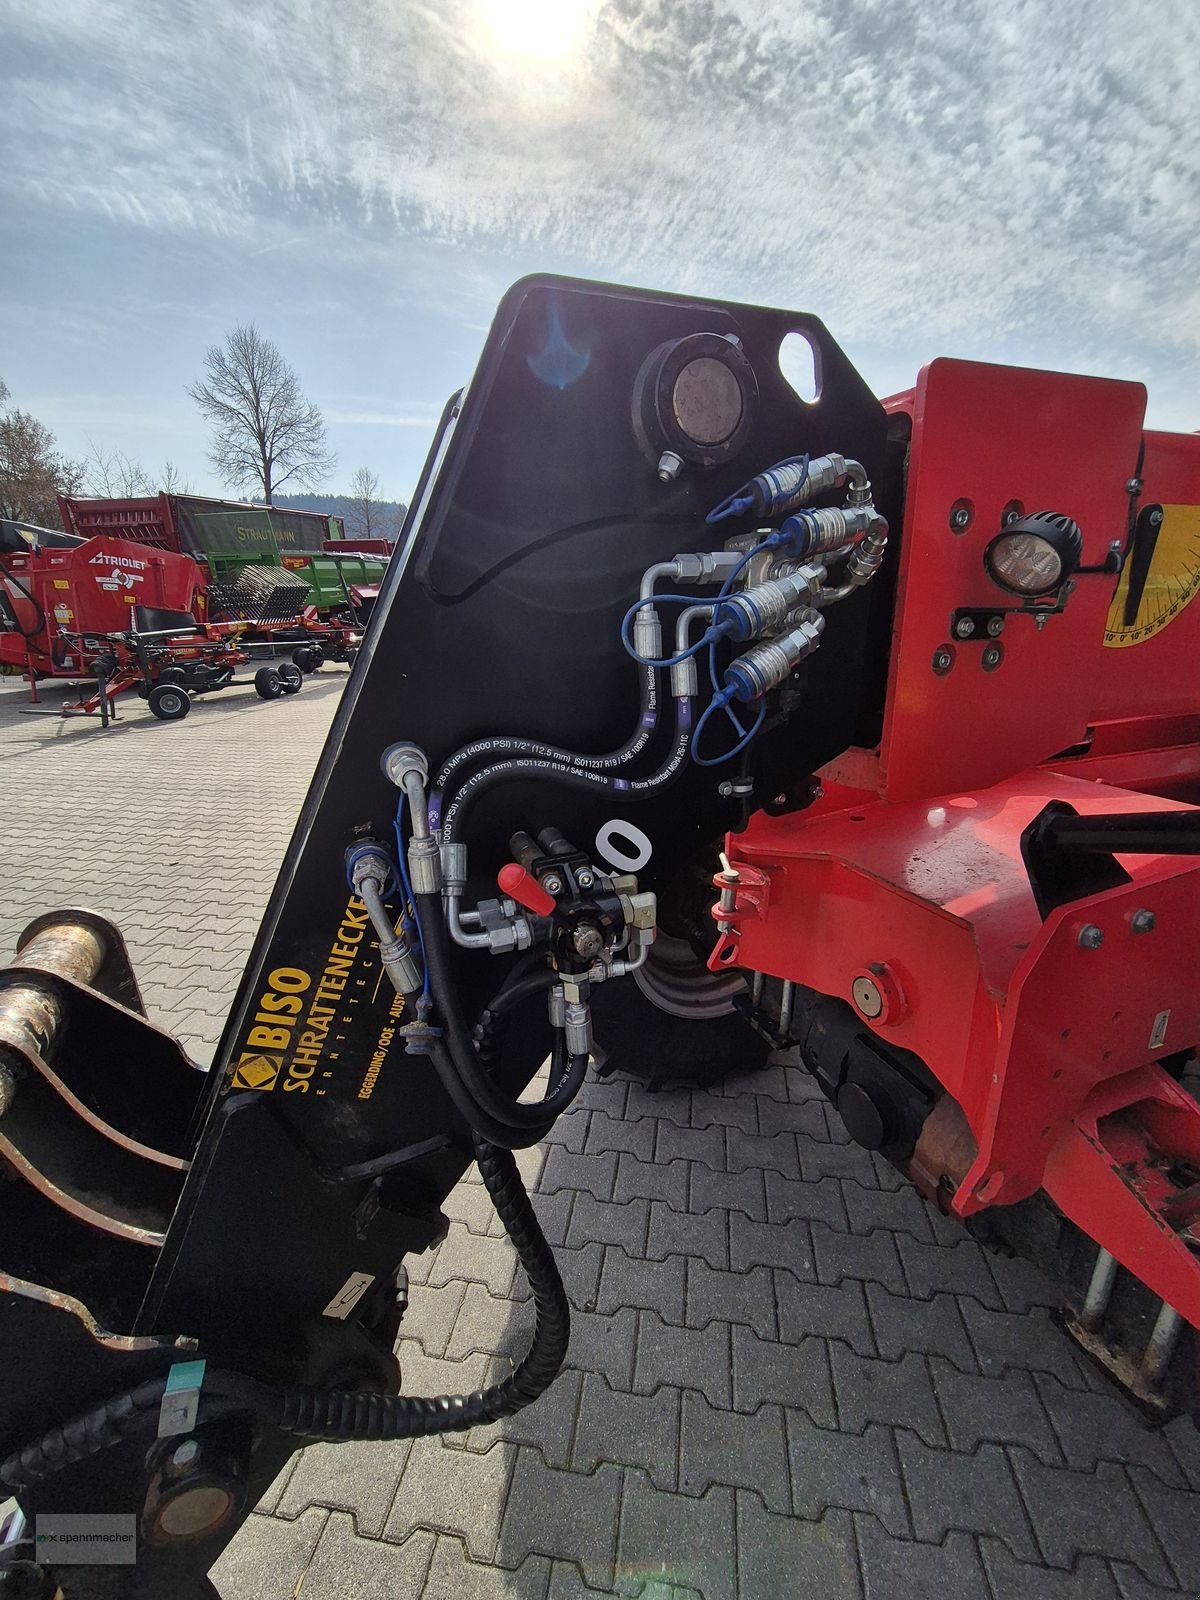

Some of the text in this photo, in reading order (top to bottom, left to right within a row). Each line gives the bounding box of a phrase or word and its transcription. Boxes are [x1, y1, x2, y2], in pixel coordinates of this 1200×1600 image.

[102, 555, 145, 570] TRIOLIET
[436, 768, 451, 787] 28.0
[449, 751, 468, 769] MPa
[467, 741, 491, 756] (4000
[493, 740, 511, 749] PSI)
[513, 741, 530, 750] 1/2"
[531, 744, 553, 757] (12.5
[553, 751, 571, 763] mm)
[574, 757, 604, 768] ISO11237
[605, 758, 617, 768] R19
[620, 751, 634, 763] SAE
[631, 732, 649, 756] 100R19
[492, 761, 512, 772] mm)
[552, 762, 566, 771] R19
[469, 768, 491, 786] (12.5
[570, 766, 584, 776] SAE
[446, 802, 459, 822] PSI)
[443, 823, 452, 844] 000
[283, 896, 370, 1093] SCHRATTENECKE
[246, 967, 311, 1050] BISO
